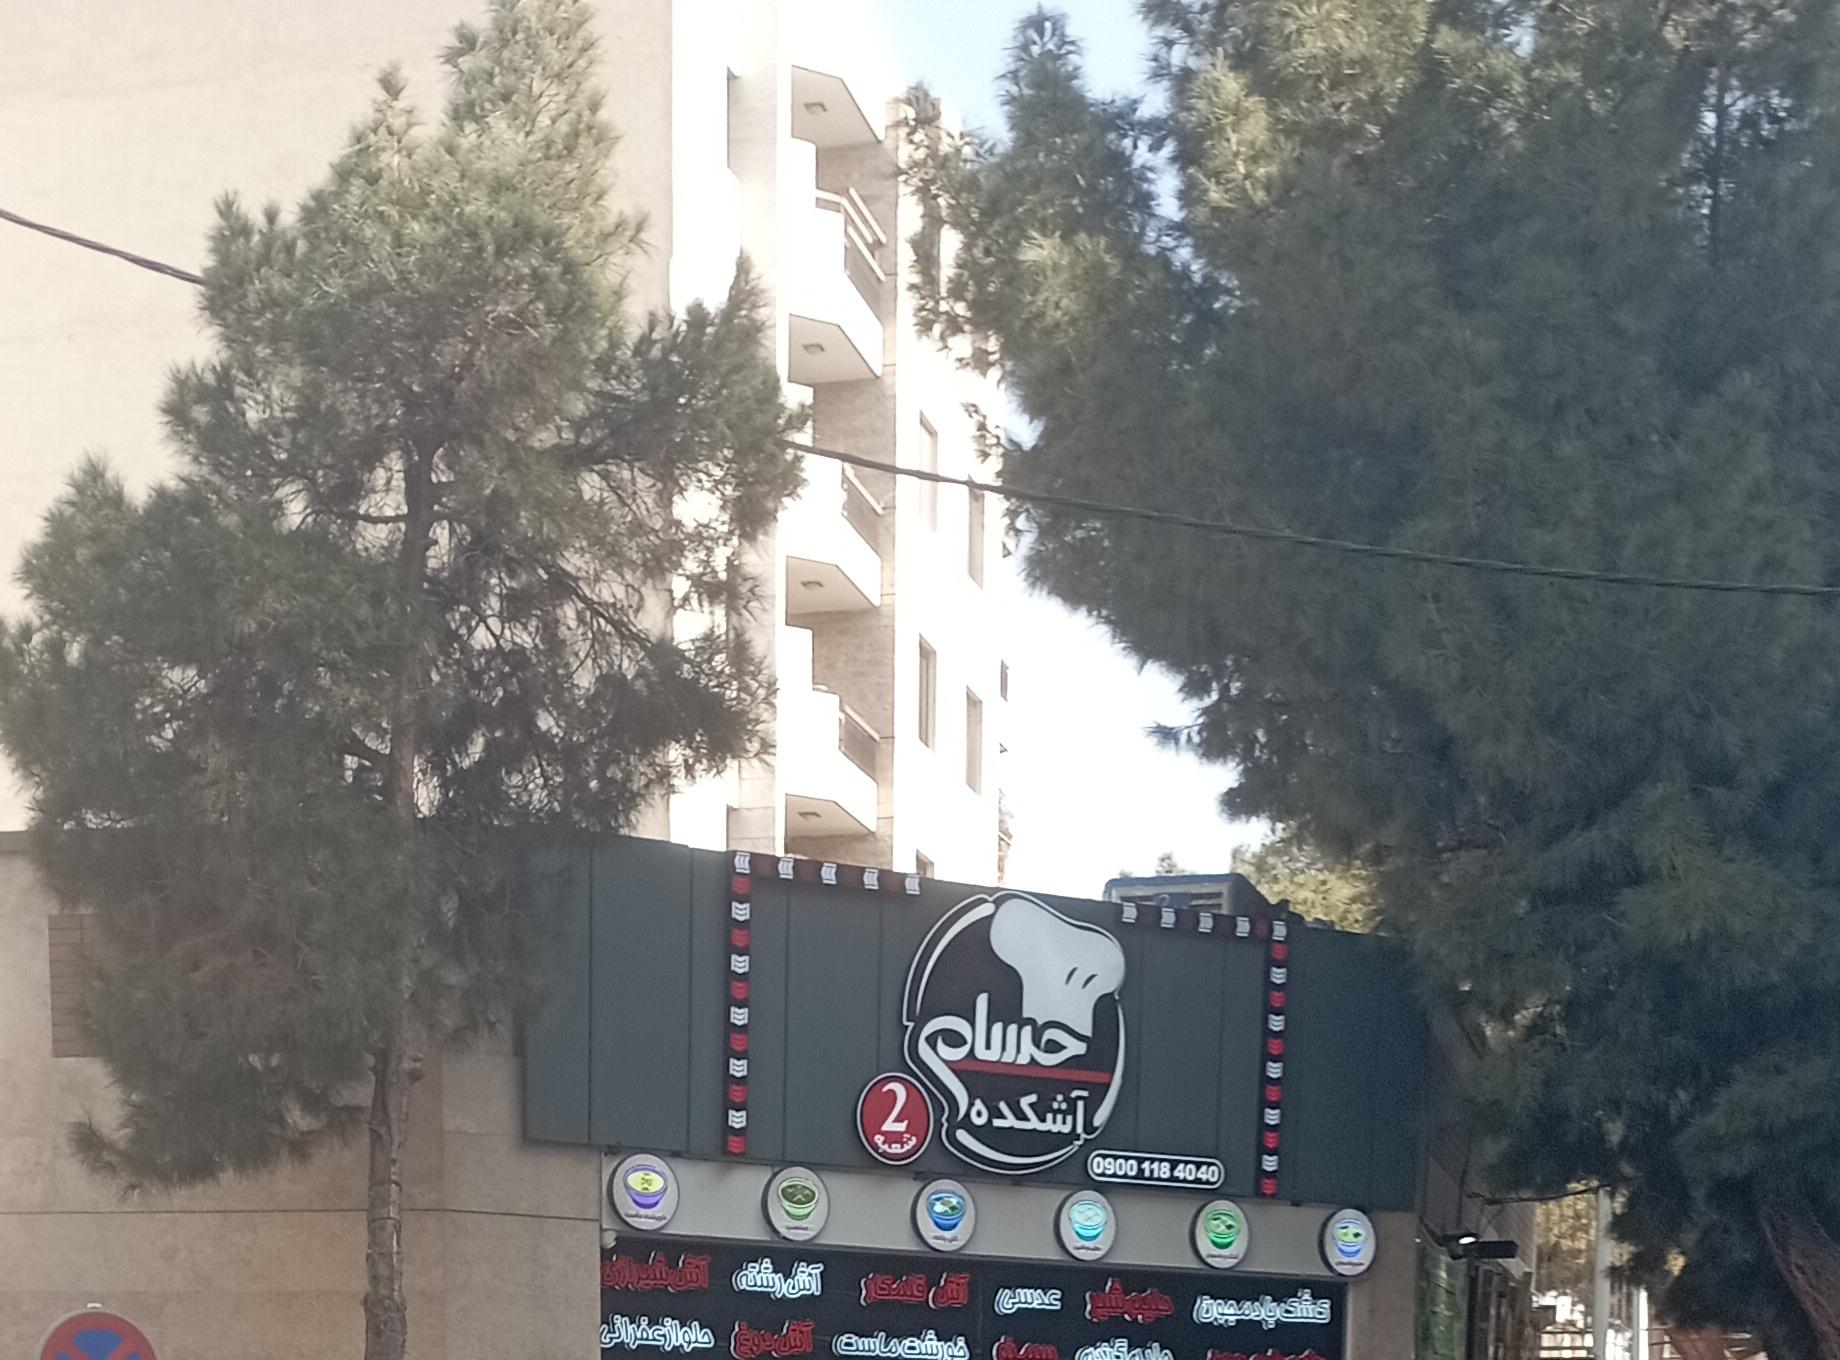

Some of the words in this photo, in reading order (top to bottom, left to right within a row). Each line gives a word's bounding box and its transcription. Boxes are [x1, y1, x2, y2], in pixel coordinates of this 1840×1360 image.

[881, 1082, 909, 1132] 2
[969, 1089, 1089, 1135] آشکده
[873, 1133, 918, 1154] شعبه
[1091, 1155, 1137, 1177] 0900
[1140, 1159, 1170, 1180] 118
[1171, 1161, 1221, 1184] 4040
[667, 1254, 711, 1293] آش
[731, 1257, 785, 1299] رشته
[784, 1260, 825, 1299] آش
[928, 1271, 970, 1310] آش
[994, 1286, 1062, 1316] عدسی
[600, 1314, 673, 1353] زعفرانی
[672, 1320, 715, 1354] حلوا
[772, 1318, 815, 1358] آش
[831, 1330, 902, 1358] ماست
